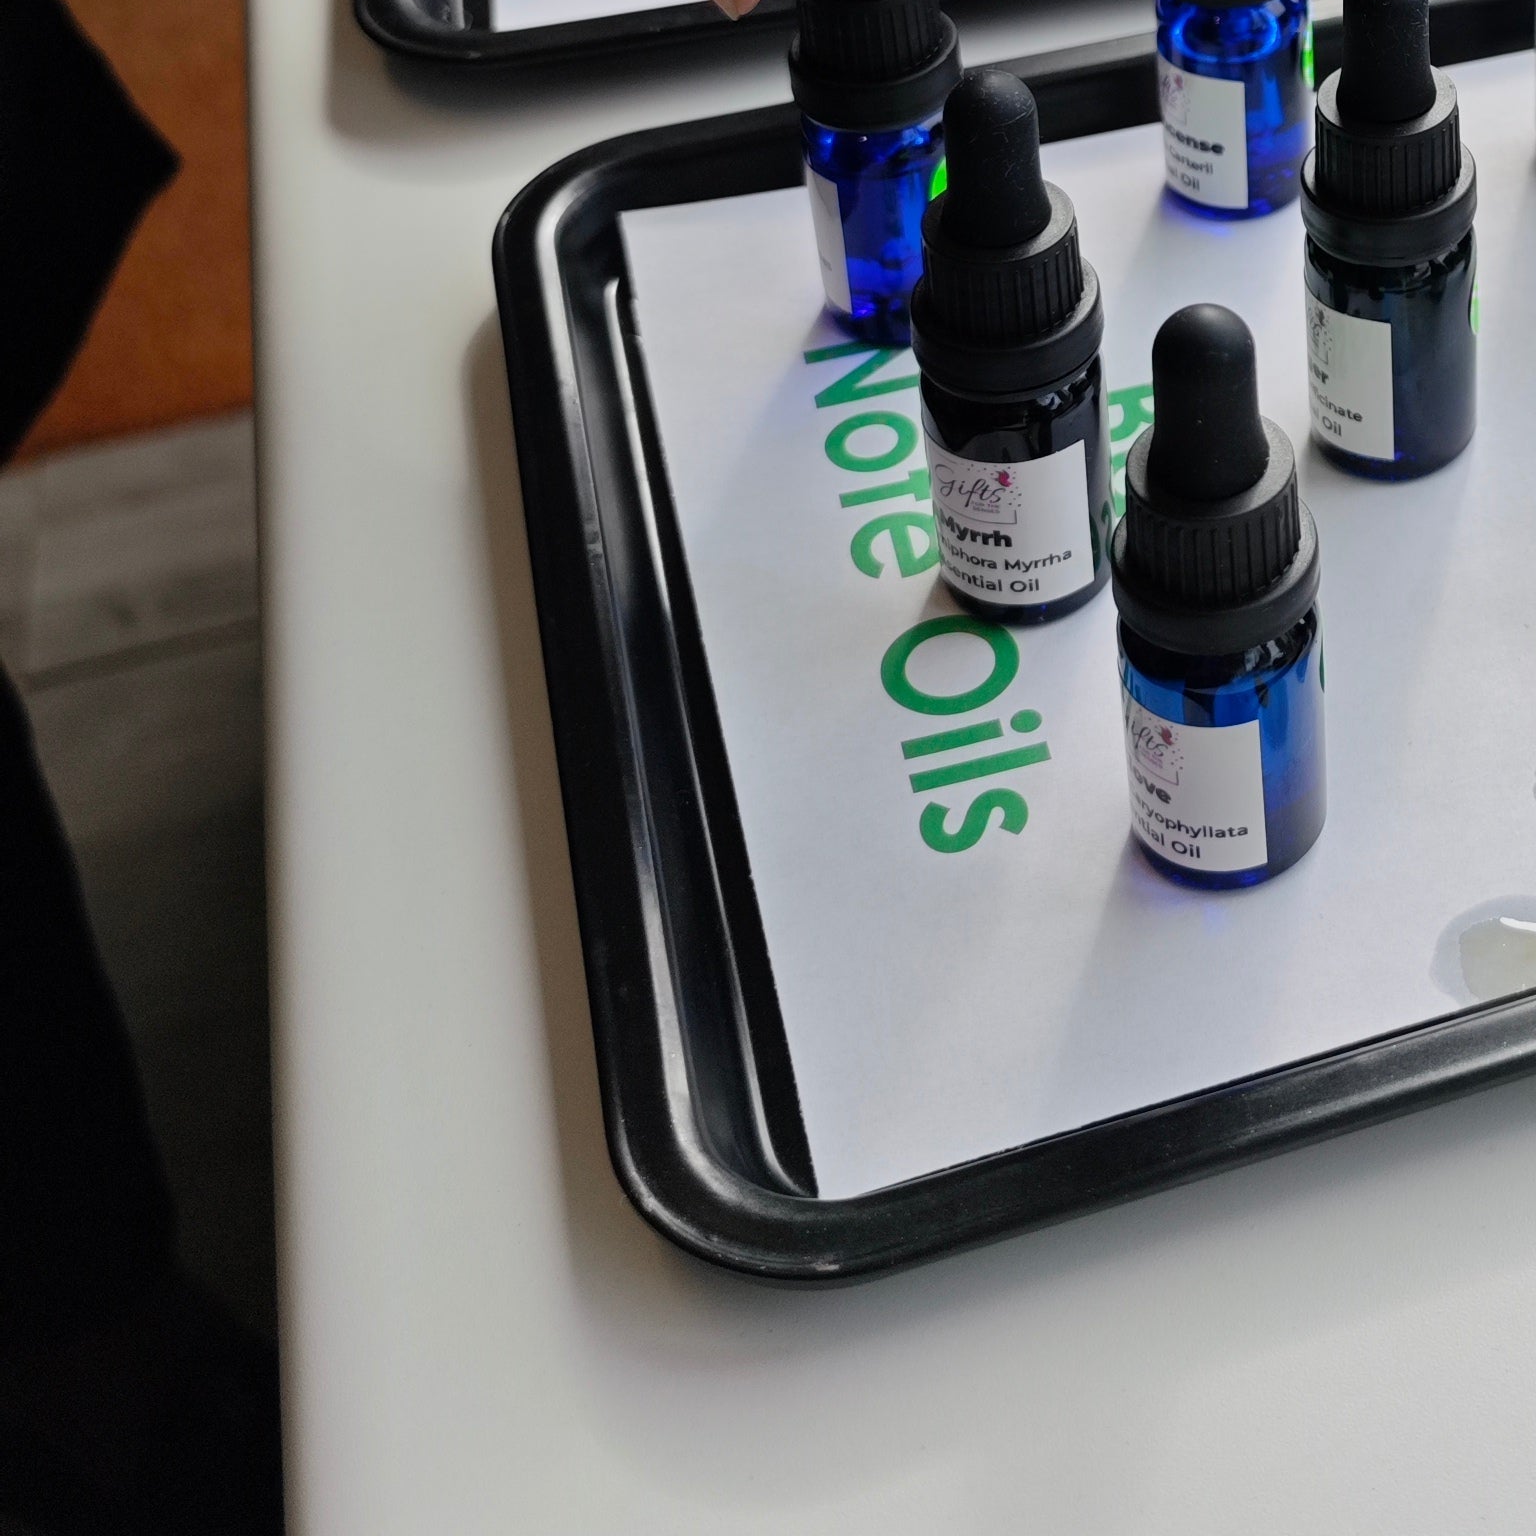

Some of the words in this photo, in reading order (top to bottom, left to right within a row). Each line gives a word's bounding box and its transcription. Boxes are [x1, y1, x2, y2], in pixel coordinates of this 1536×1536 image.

[1322, 416, 1342, 437] Oil
[934, 462, 1006, 508] Gifts
[939, 507, 1014, 548] Myrrh
[1004, 549, 1073, 574] Myrrha
[1009, 578, 1040, 593] Oil
[880, 614, 1053, 854] Oils
[1171, 840, 1201, 859] Oil
